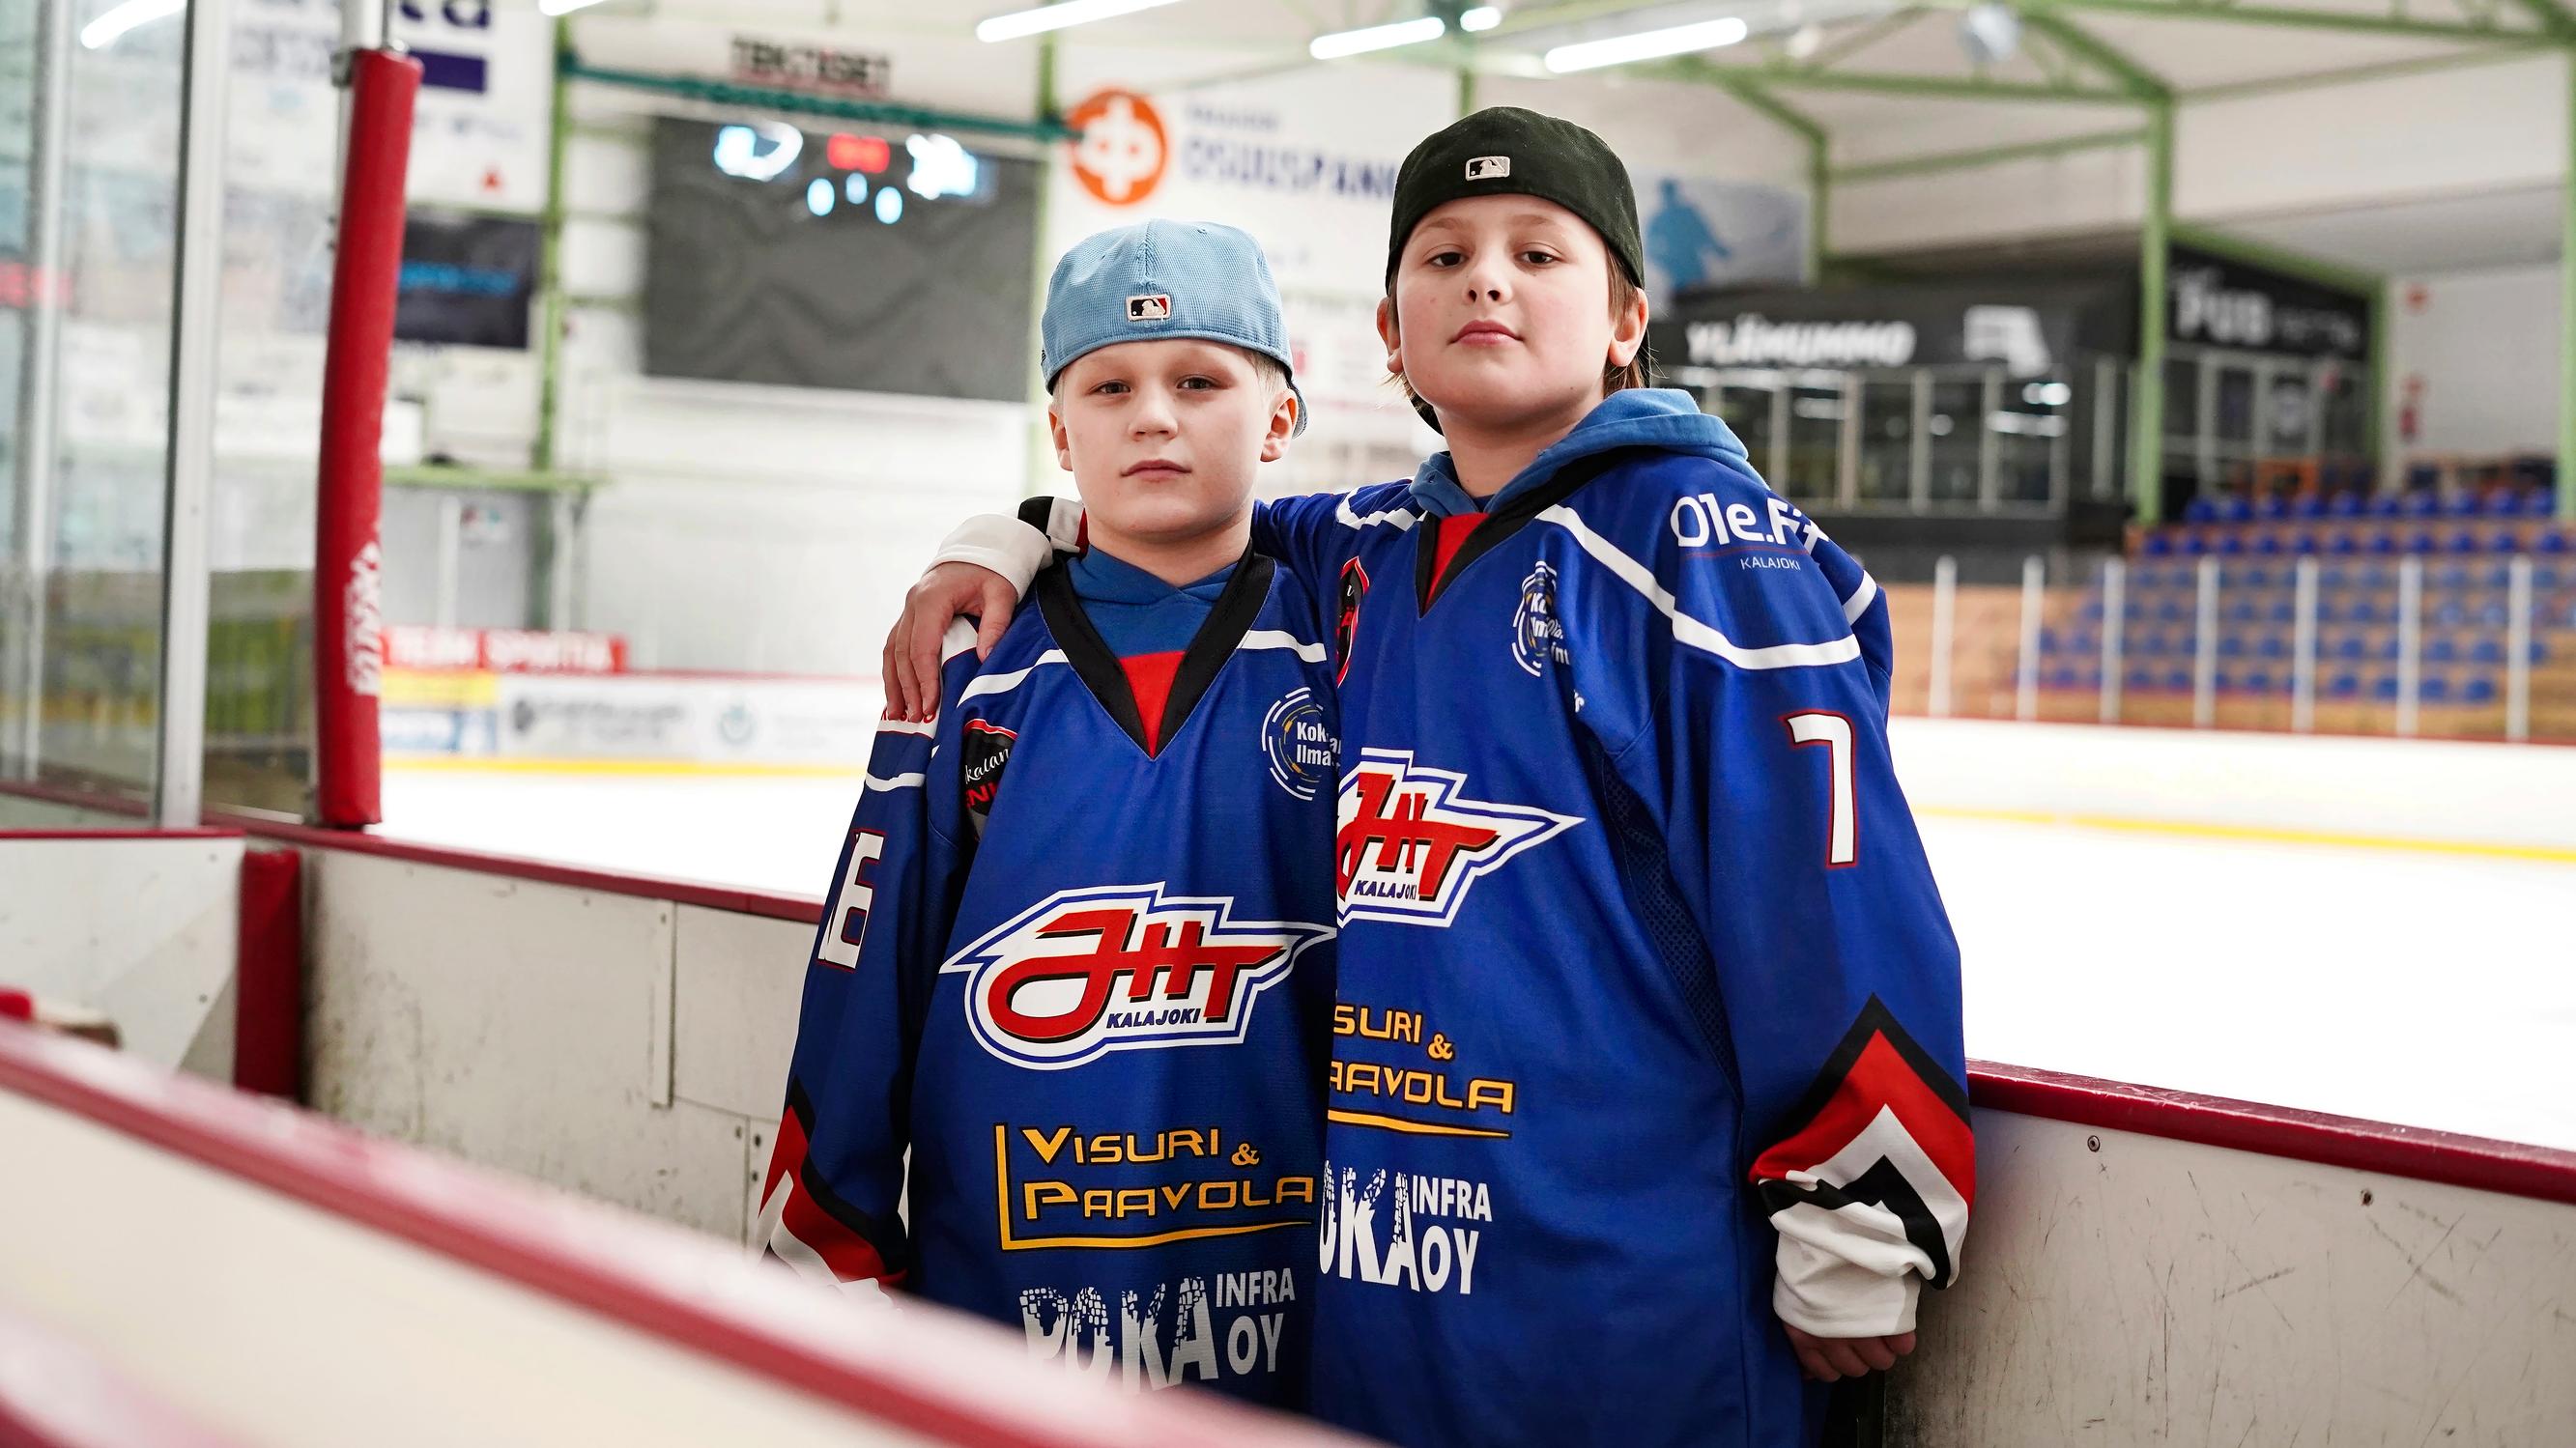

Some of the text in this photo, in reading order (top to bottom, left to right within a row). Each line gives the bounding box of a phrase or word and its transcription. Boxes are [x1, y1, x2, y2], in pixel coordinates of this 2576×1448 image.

[1740, 556, 1801, 571] KALAJOKI
[1780, 709, 1858, 868] 7
[1354, 880, 1417, 900] KALAJOKI
[1106, 1008, 1199, 1029] KALAJOKI
[1428, 1034, 1453, 1060] &
[1022, 1127, 1259, 1166] VISURI &
[1024, 1177, 1313, 1219] PAAVOLA
[1413, 1174, 1492, 1222] INFRA
[1421, 1225, 1479, 1294] OY
[1216, 1267, 1296, 1308] INFRA
[1227, 1313, 1284, 1376] OY
